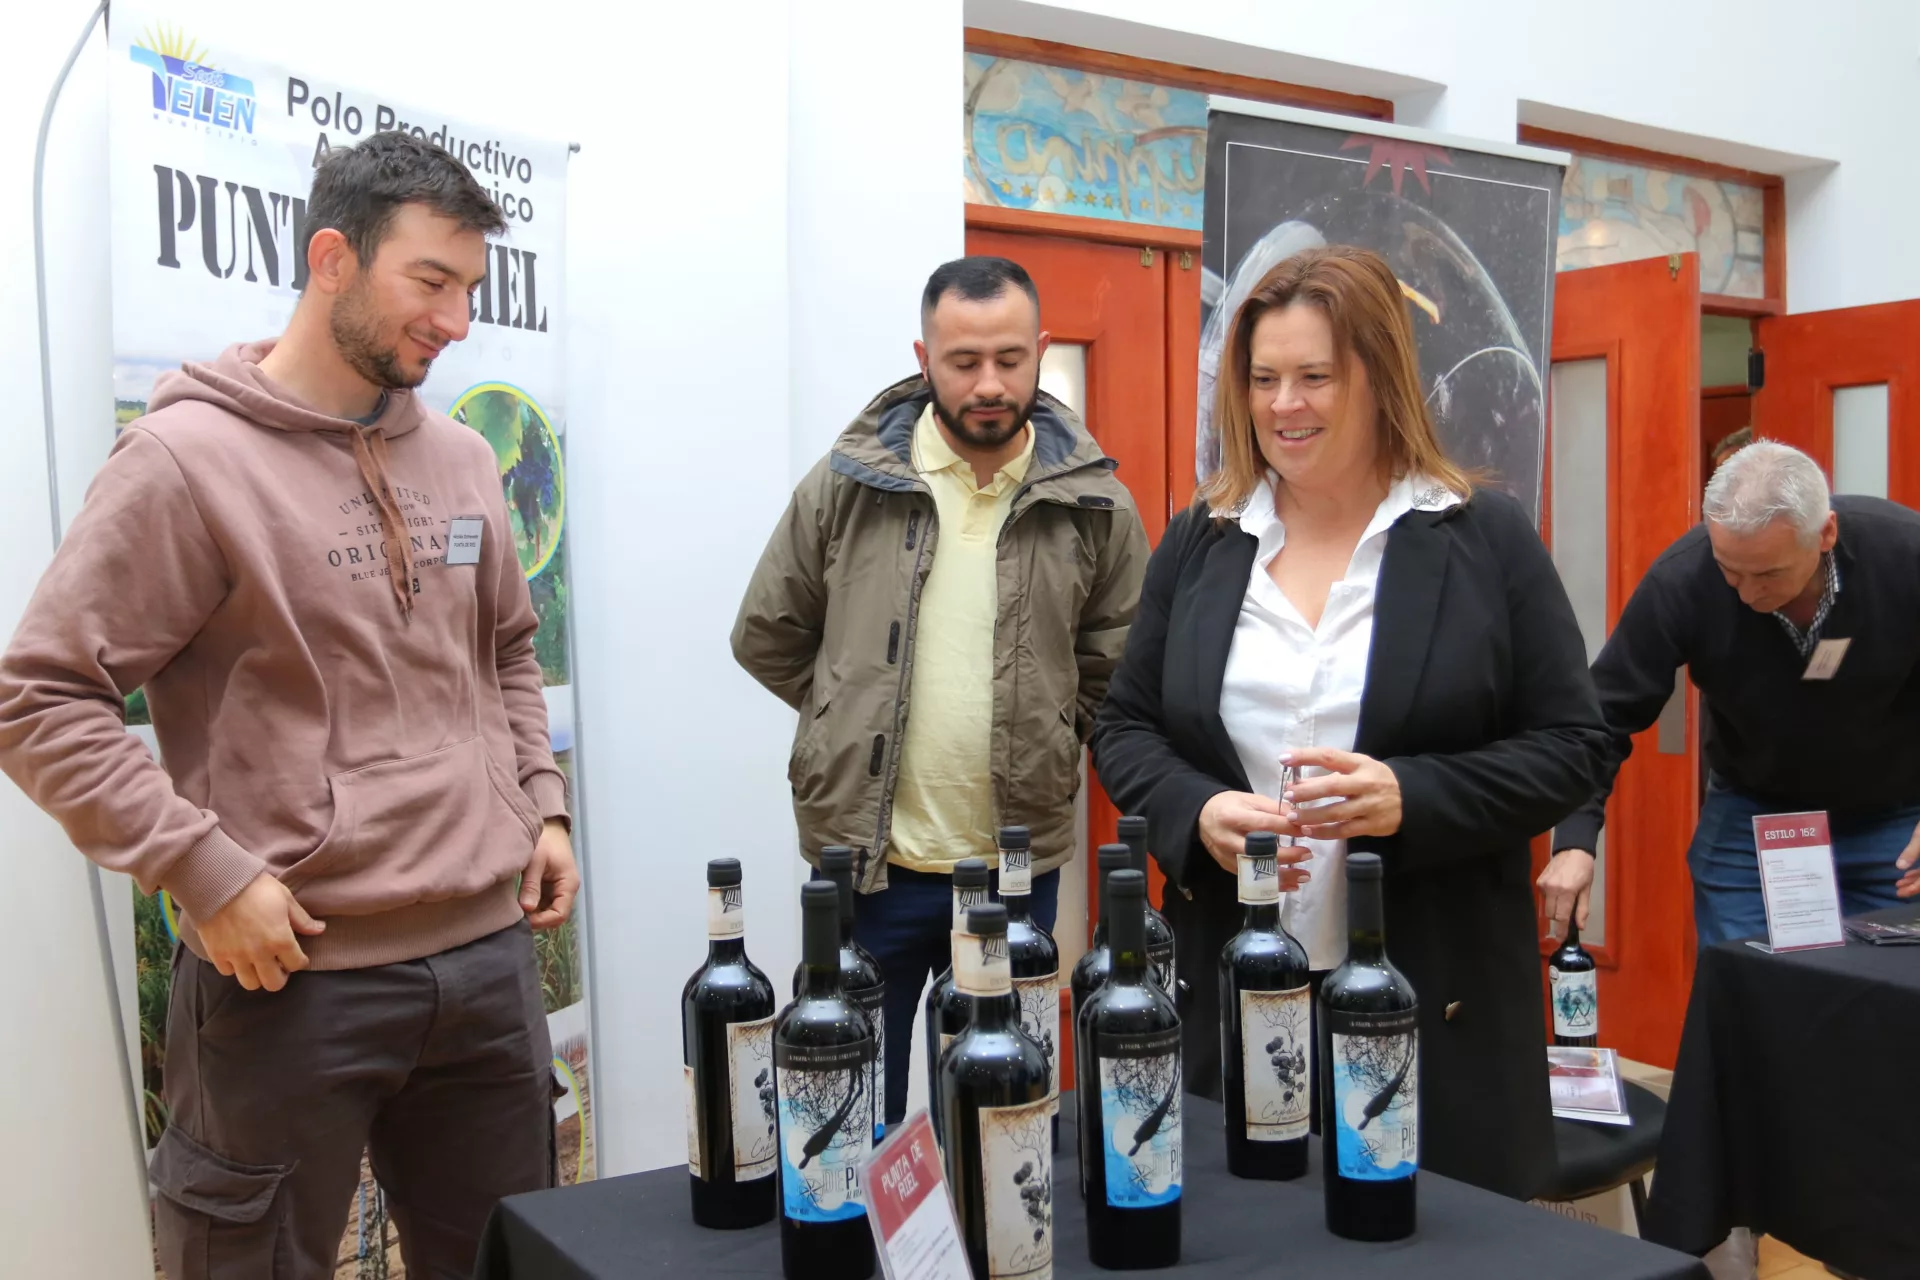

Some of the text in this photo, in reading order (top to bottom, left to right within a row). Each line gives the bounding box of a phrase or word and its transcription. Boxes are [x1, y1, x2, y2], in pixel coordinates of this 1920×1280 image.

[288, 76, 363, 135] Polo
[153, 164, 308, 291] PUNT
[469, 241, 548, 333] IEL
[356, 522, 384, 536] SIXT
[351, 570, 376, 581] BLUE
[1764, 827, 1816, 841] ESTILO 152
[881, 1139, 924, 1195] PUNTA DE
[897, 1172, 919, 1202] RIEL
